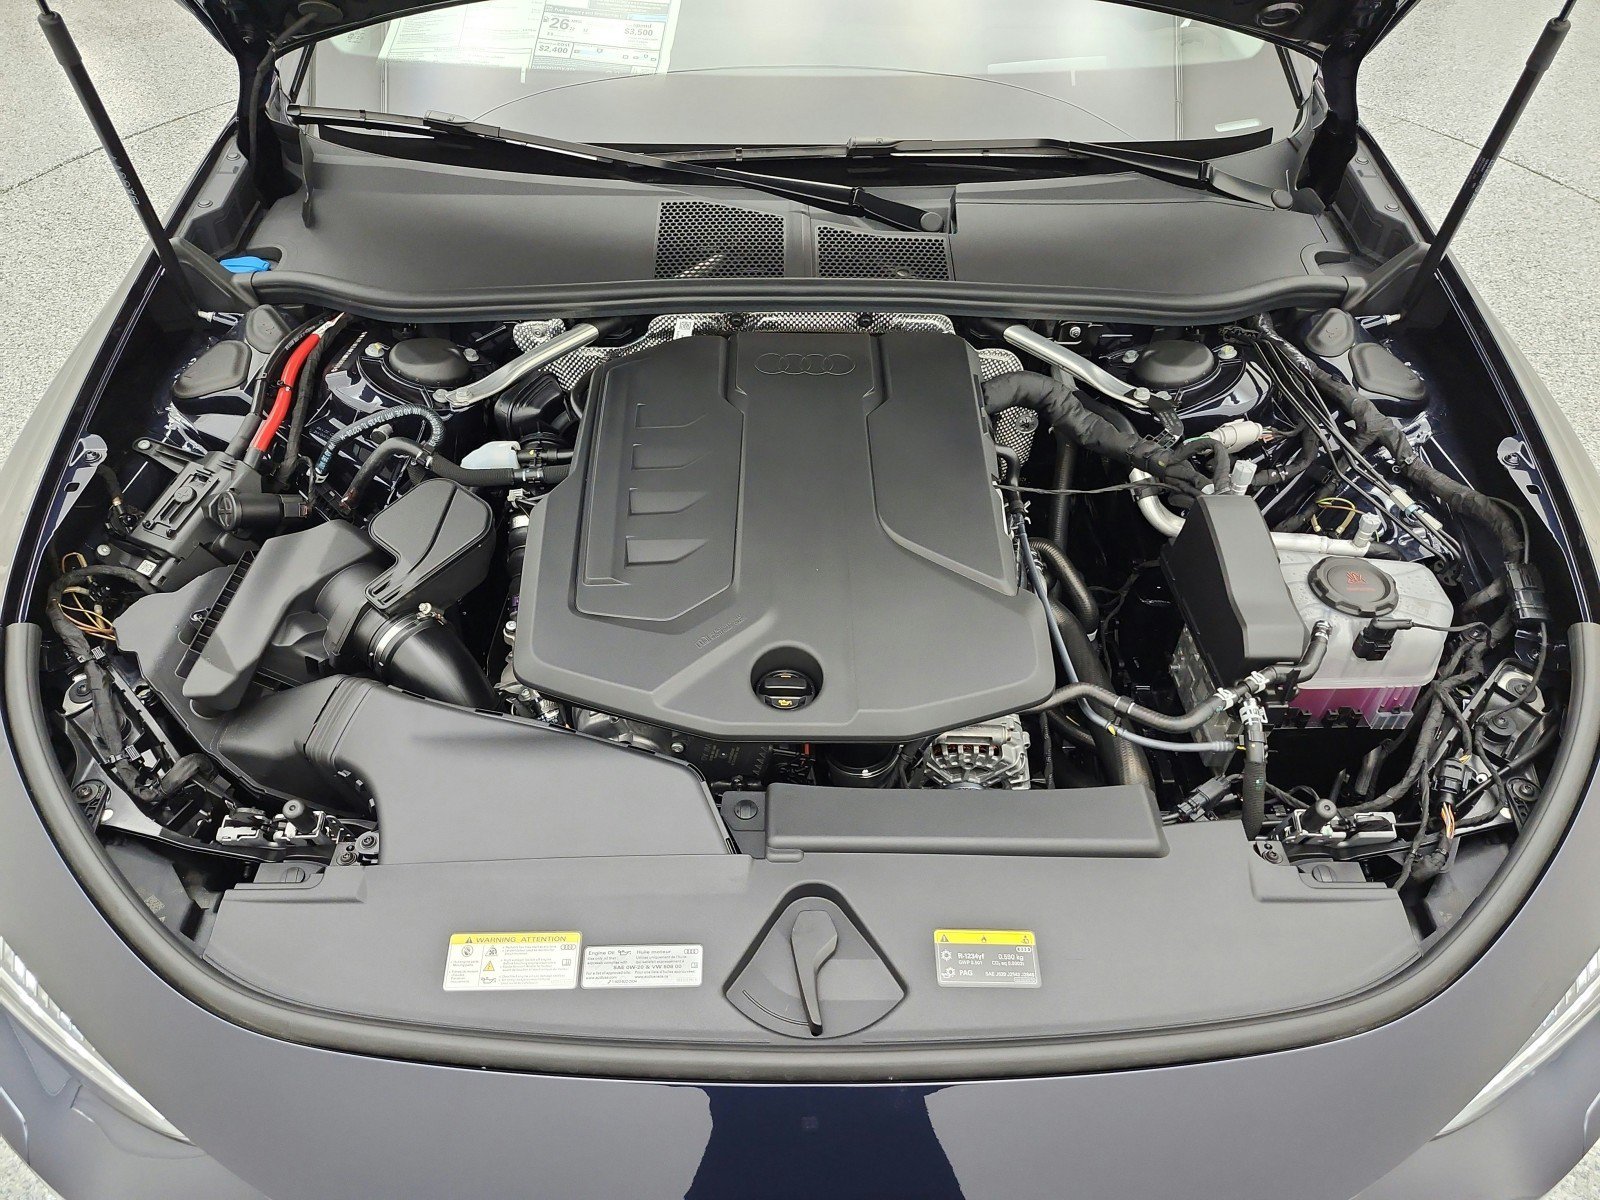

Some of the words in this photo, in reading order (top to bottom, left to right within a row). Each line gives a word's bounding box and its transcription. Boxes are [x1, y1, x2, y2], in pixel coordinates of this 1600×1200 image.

[549, 17, 569, 30] 26
[624, 28, 653, 36] $3,500
[538, 45, 568, 54] $2,400
[1016, 954, 1024, 962] kg
